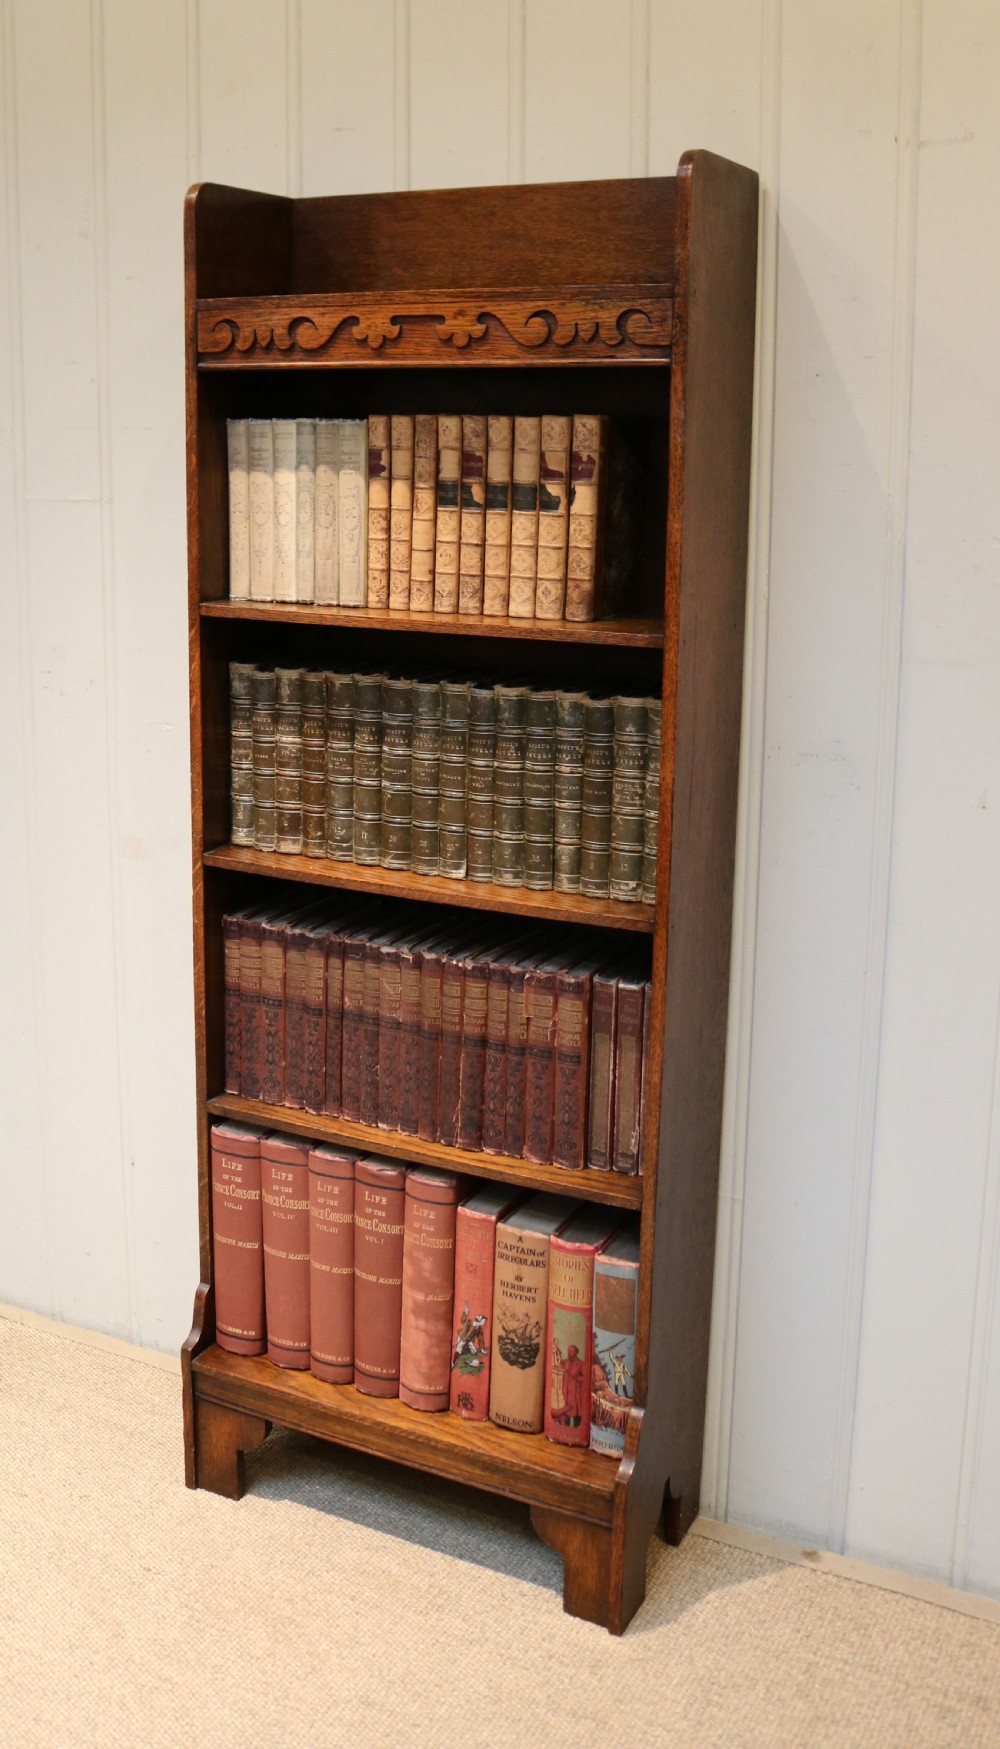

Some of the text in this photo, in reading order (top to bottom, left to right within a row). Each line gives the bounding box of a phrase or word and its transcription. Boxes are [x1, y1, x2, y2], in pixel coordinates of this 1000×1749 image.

[222, 1158, 242, 1171] LIFE
[272, 1168, 293, 1181] LIFE
[317, 1181, 339, 1194] LIFE
[364, 1191, 387, 1205] LIFE
[325, 1208, 354, 1223] CONSOR
[413, 1205, 436, 1219] LIFE
[497, 1241, 546, 1257] CAPTAIN of
[497, 1252, 546, 1269] IRREGULARS
[553, 1256, 589, 1271] STORIES
[564, 1273, 576, 1284] OF
[500, 1279, 539, 1295] HERBERT
[502, 1289, 536, 1304] HAYENS
[495, 1412, 533, 1429] NELSON
